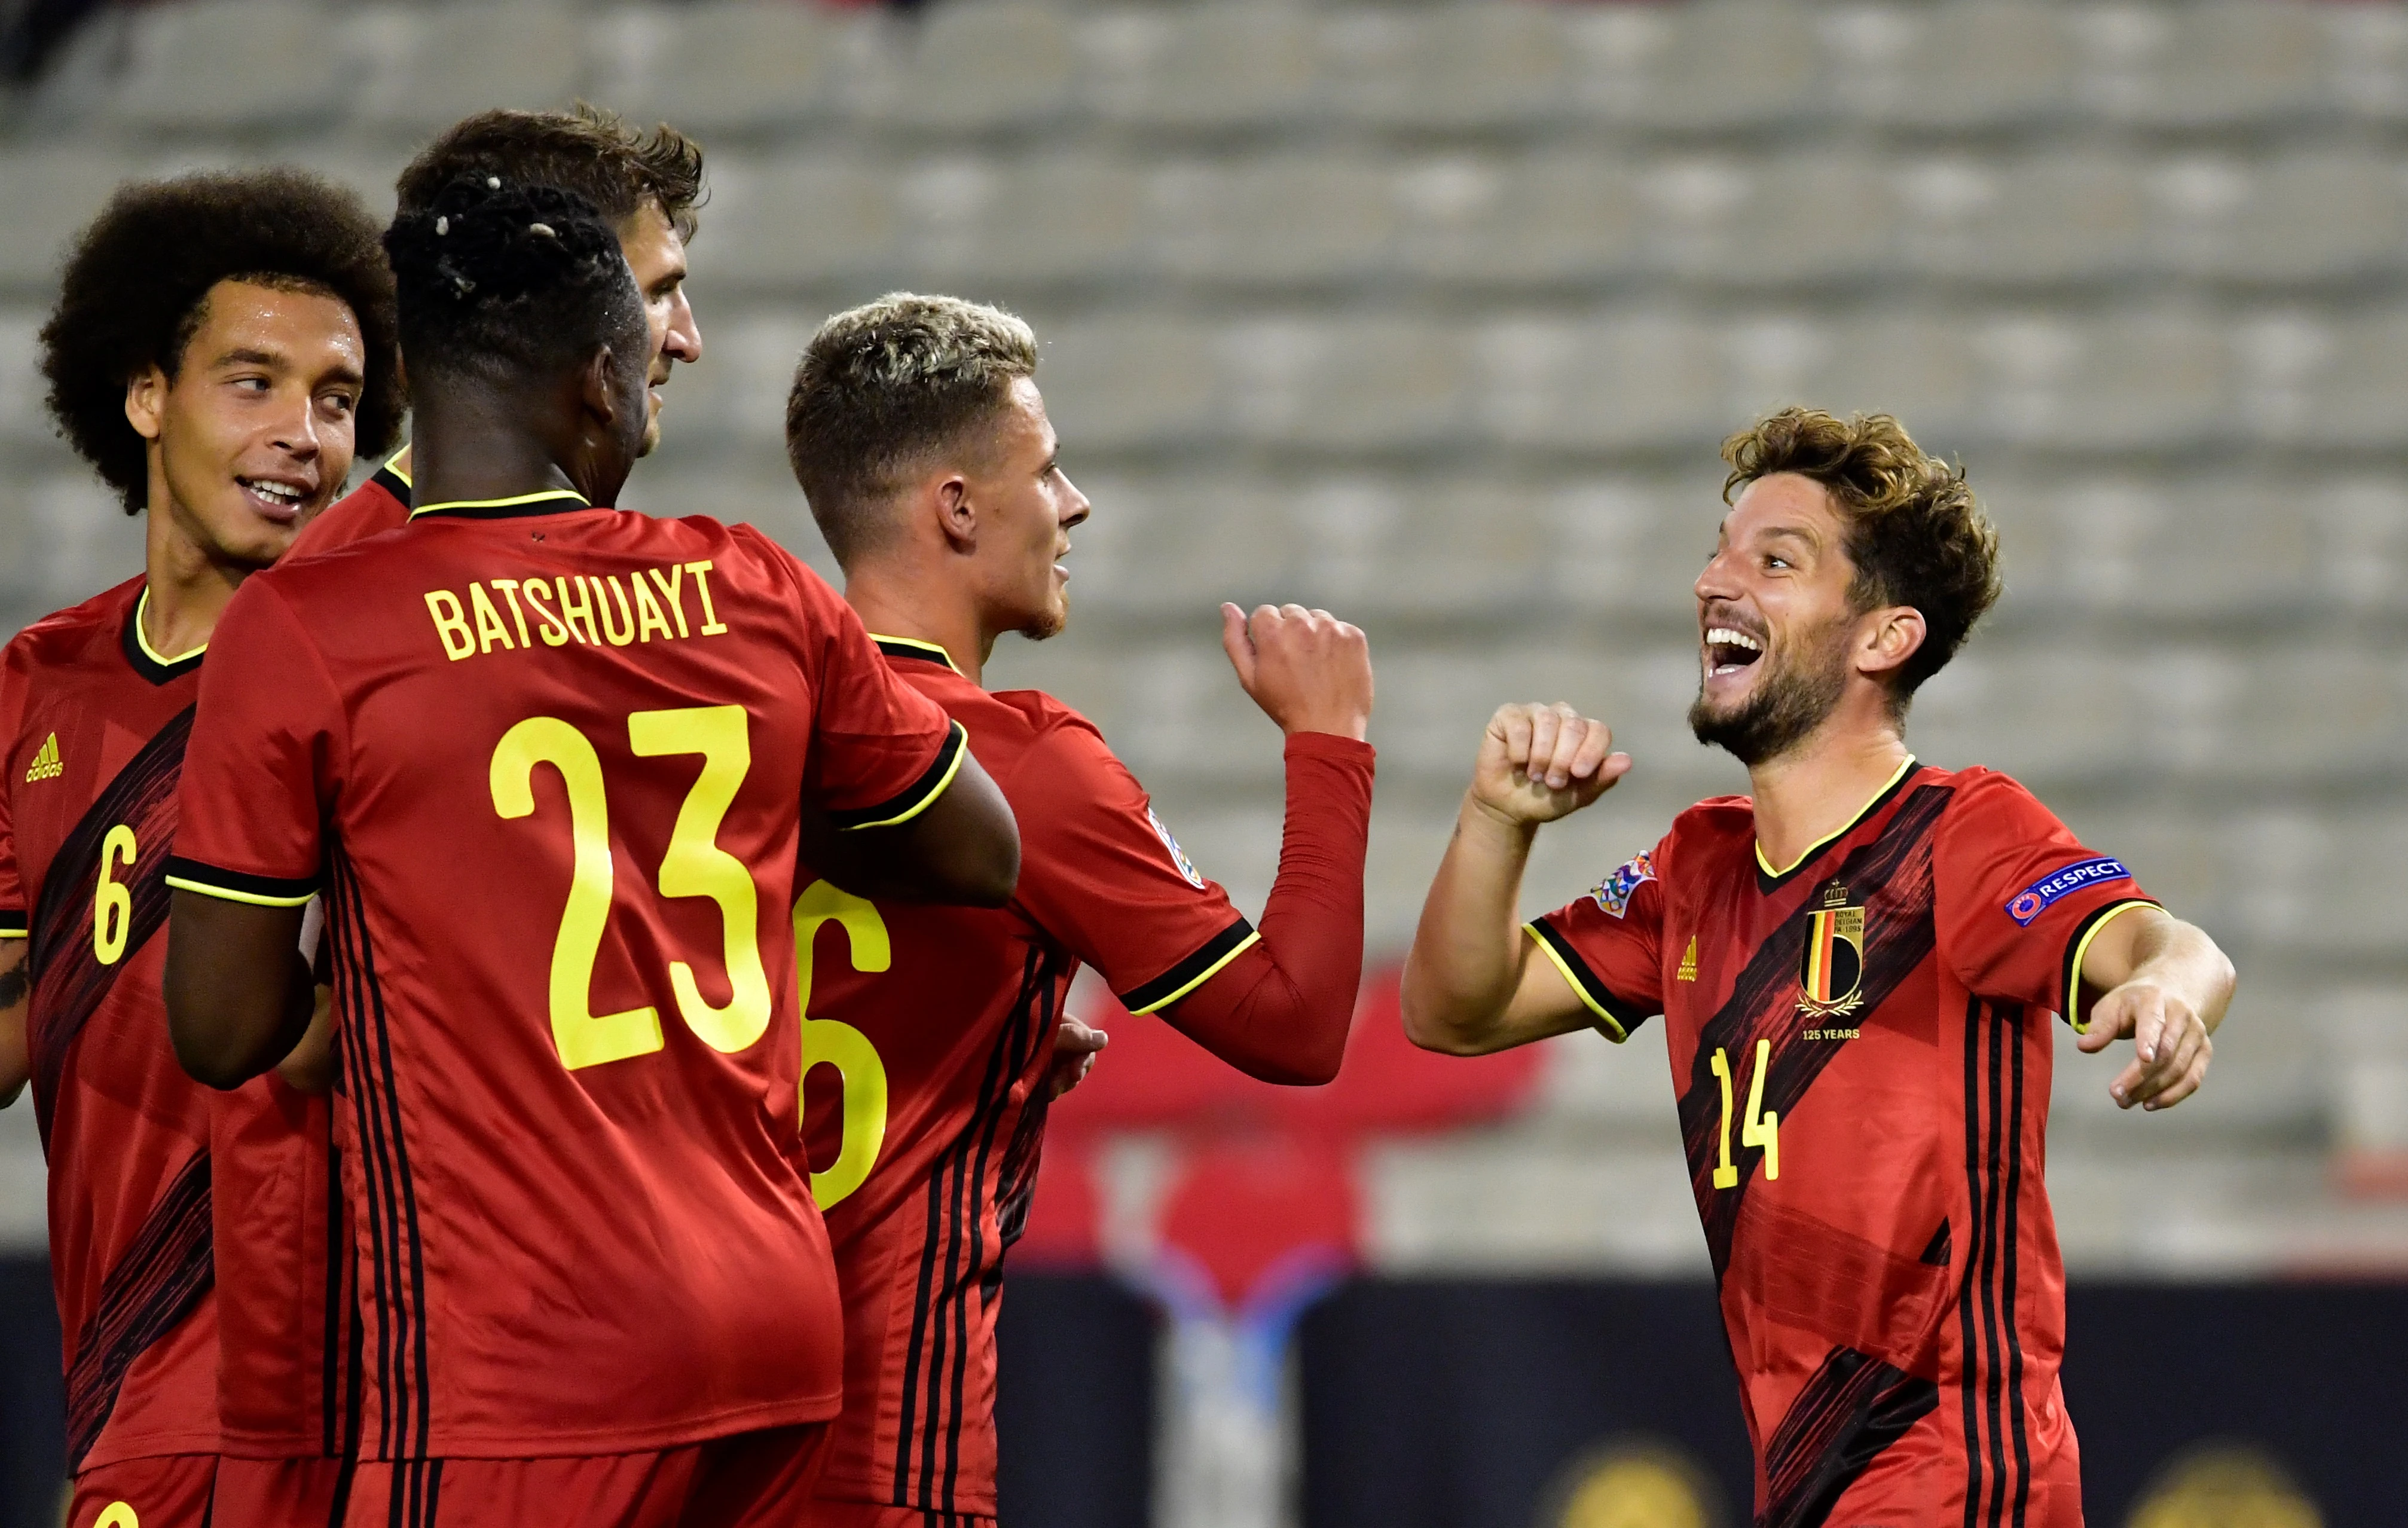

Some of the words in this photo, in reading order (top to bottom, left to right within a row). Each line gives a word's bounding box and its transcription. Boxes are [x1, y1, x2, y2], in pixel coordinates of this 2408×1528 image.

[424, 560, 728, 662] BATSHUAYI
[94, 824, 136, 965] 6
[489, 704, 772, 1070] 23
[2039, 862, 2122, 897] RESPECT
[1802, 1029, 1821, 1040] 125
[1823, 1029, 1860, 1039] YEARS
[1711, 1039, 1779, 1189] 14
